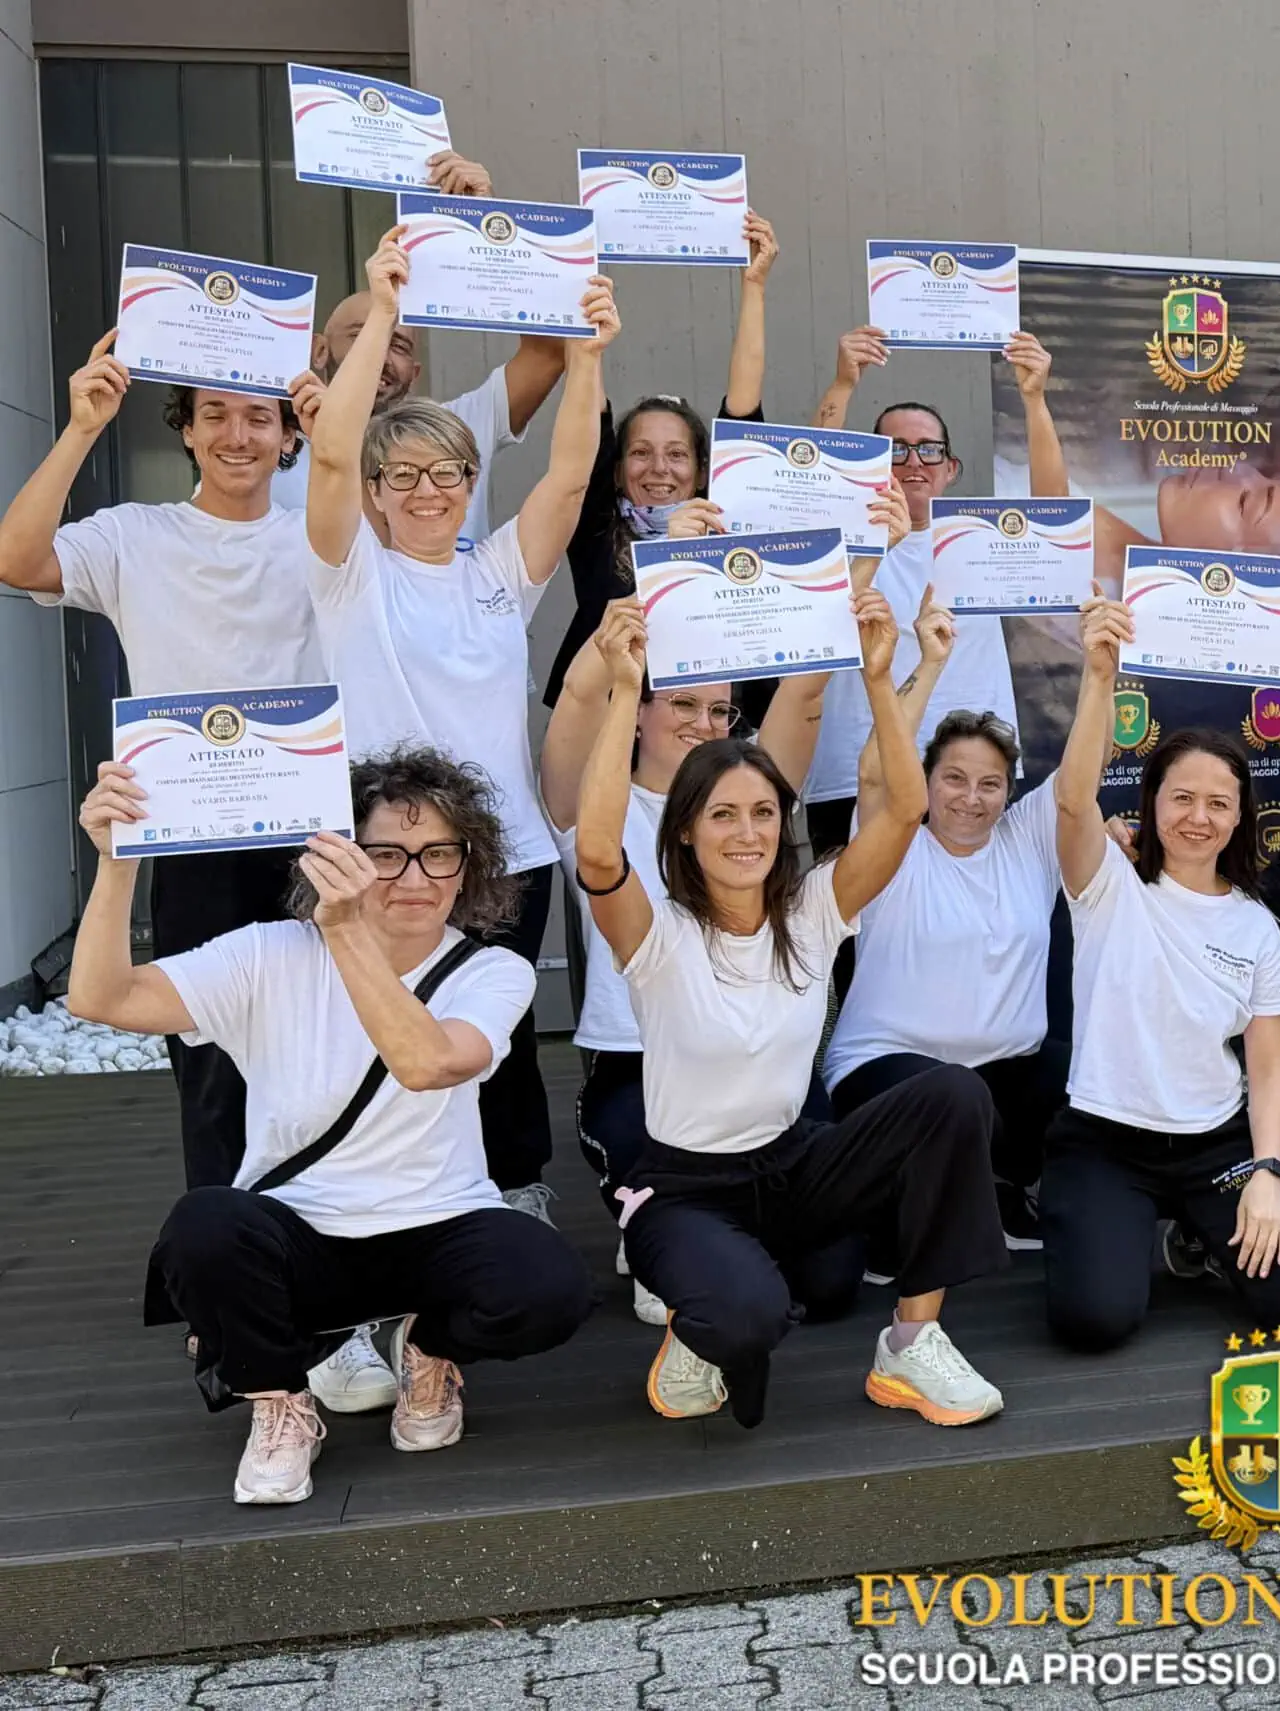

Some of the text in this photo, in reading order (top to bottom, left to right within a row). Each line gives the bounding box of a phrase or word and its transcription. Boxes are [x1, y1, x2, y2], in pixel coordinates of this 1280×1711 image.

[350, 116, 403, 129] ATTESTATO
[638, 192, 692, 200] ATTESTATO
[432, 206, 483, 217] EVOLUTION
[467, 246, 532, 259] ATTESTATO
[920, 281, 969, 290] ATTESTATO
[187, 304, 251, 321] ATTESTATO
[1133, 400, 1258, 416] Scuola Professionale di Massaggio
[744, 432, 790, 443] EVOLUTION
[1119, 418, 1272, 444] EVOLUTION
[774, 469, 832, 482] ATTESTATO
[988, 542, 1040, 550] ATTESTATO
[670, 548, 725, 561] EVOLUTION
[1157, 558, 1205, 568] EVOLUTION
[714, 585, 781, 600] ATTESTATO
[1186, 598, 1246, 610] ATTESTATO
[147, 705, 204, 718] EVOLUTION
[188, 748, 265, 763] ATTESTATO
[1260, 757, 1269, 767] di
[1116, 765, 1125, 776] di
